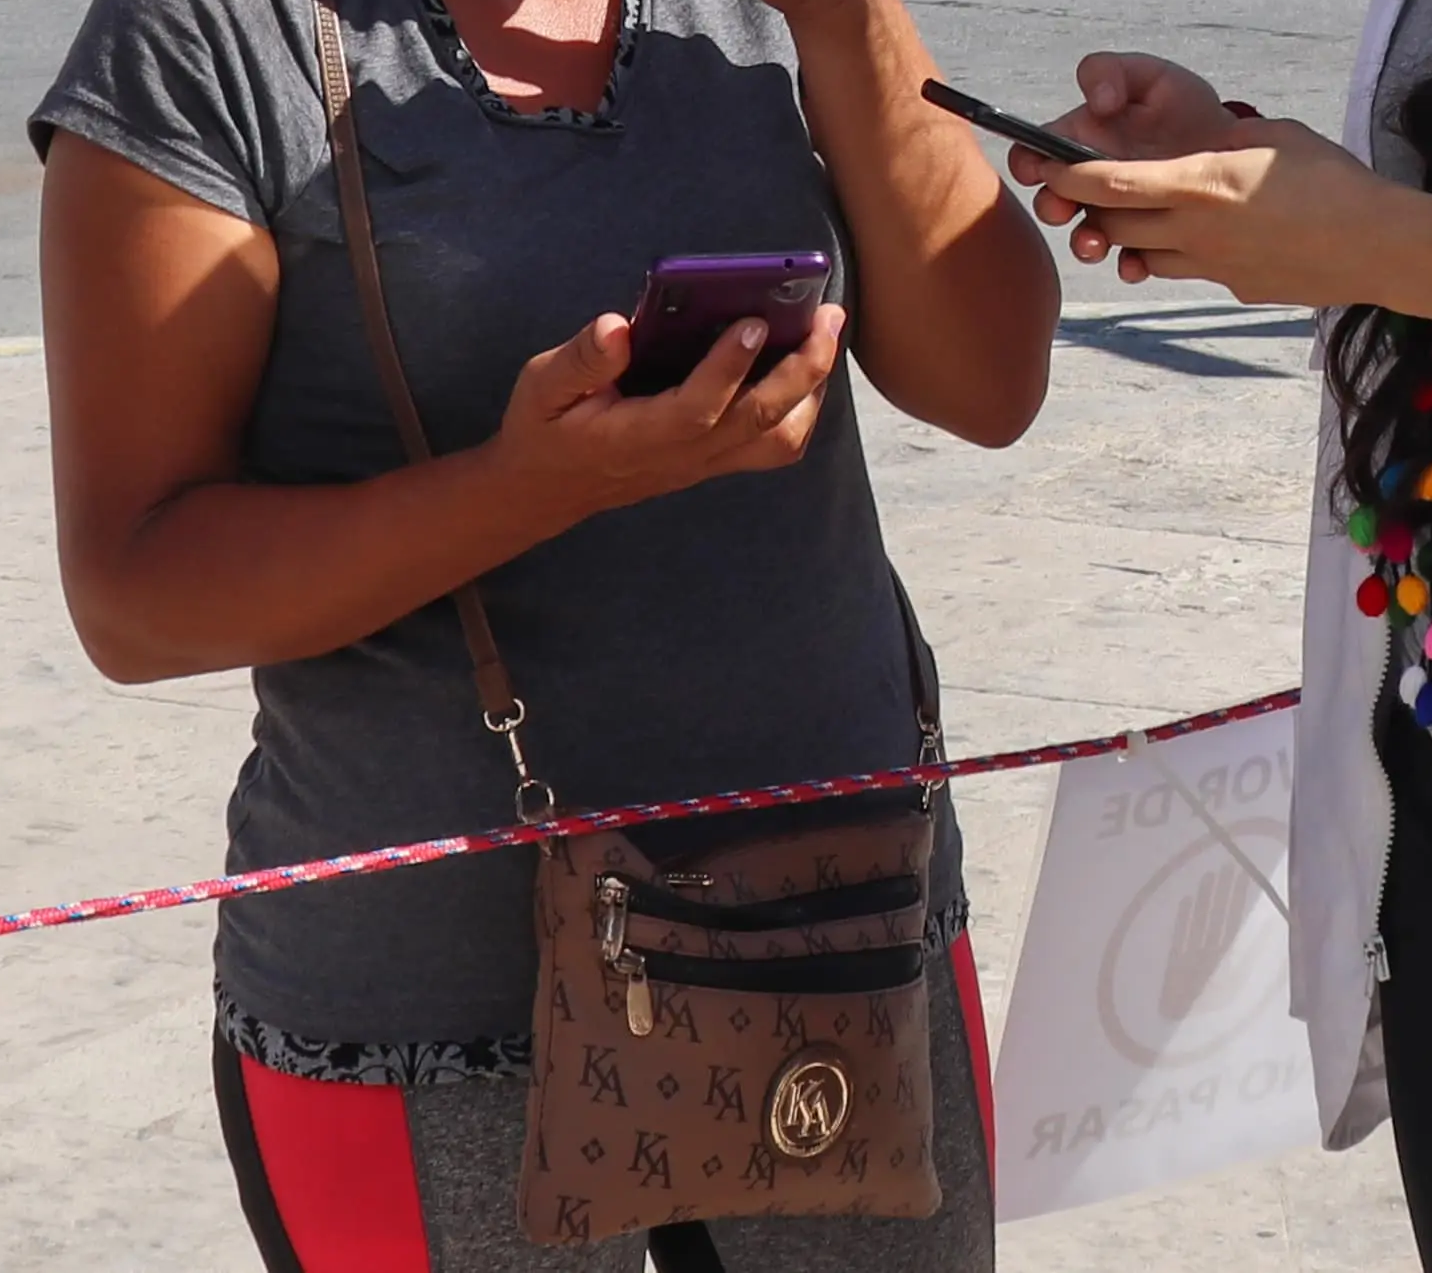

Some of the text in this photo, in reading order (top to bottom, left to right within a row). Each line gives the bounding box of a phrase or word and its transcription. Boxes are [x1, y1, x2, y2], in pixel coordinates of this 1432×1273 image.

[579, 1044, 629, 1108] KA
[703, 1065, 748, 1122] KA
[784, 1078, 832, 1138] KA
[628, 1130, 673, 1190] KA
[553, 1195, 591, 1243] KA
